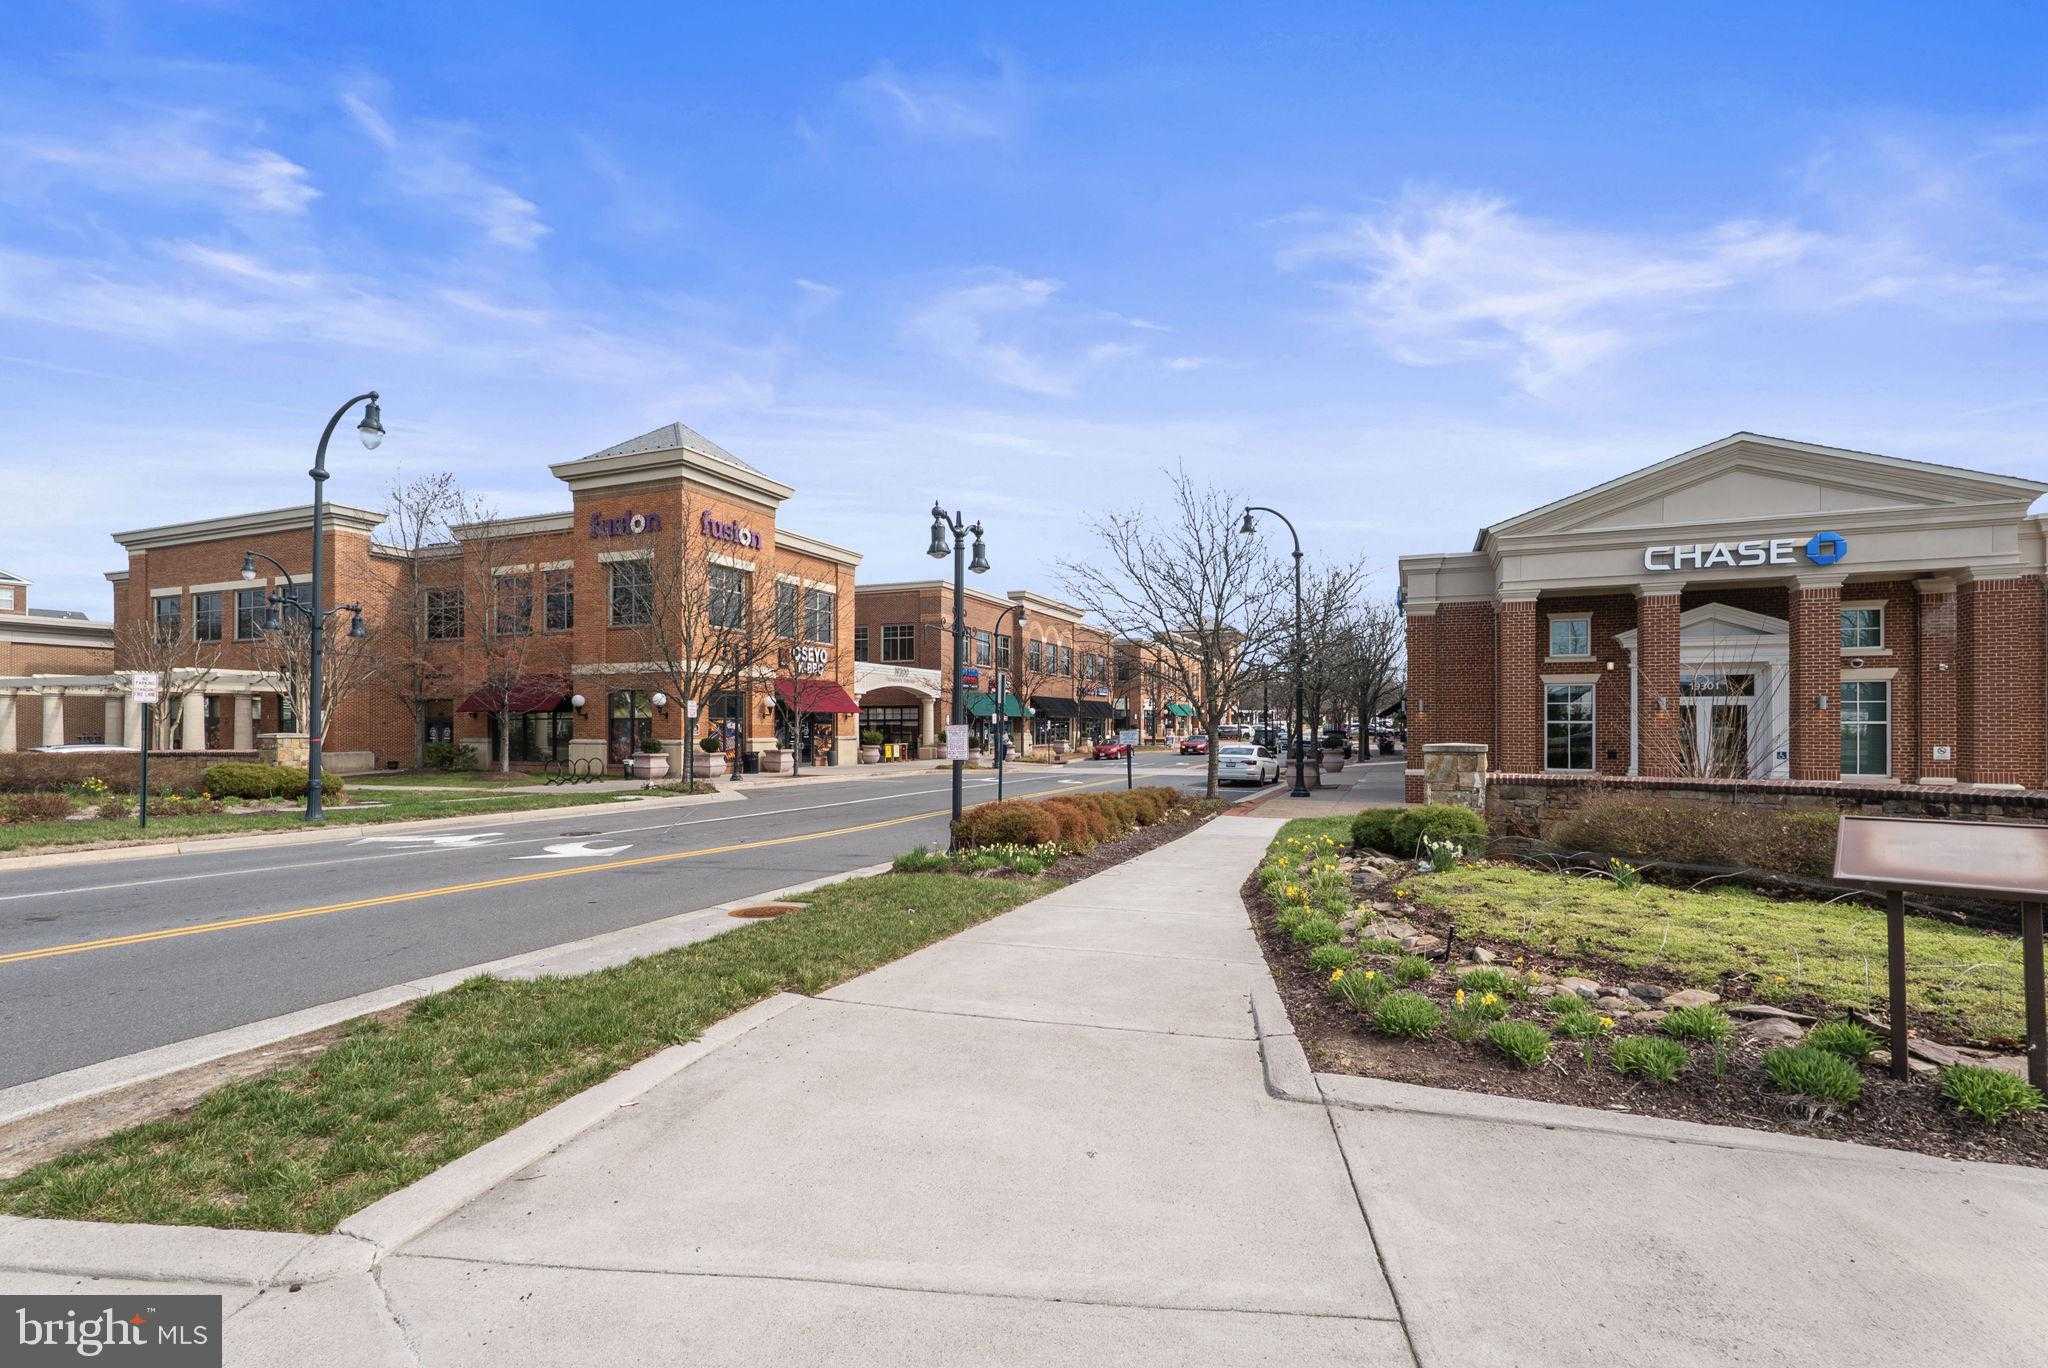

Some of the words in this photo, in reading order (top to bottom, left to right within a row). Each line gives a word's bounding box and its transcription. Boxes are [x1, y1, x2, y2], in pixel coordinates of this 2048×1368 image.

[590, 511, 662, 539] fusion
[700, 509, 763, 550] fusion
[1643, 539, 1797, 571] CHASE
